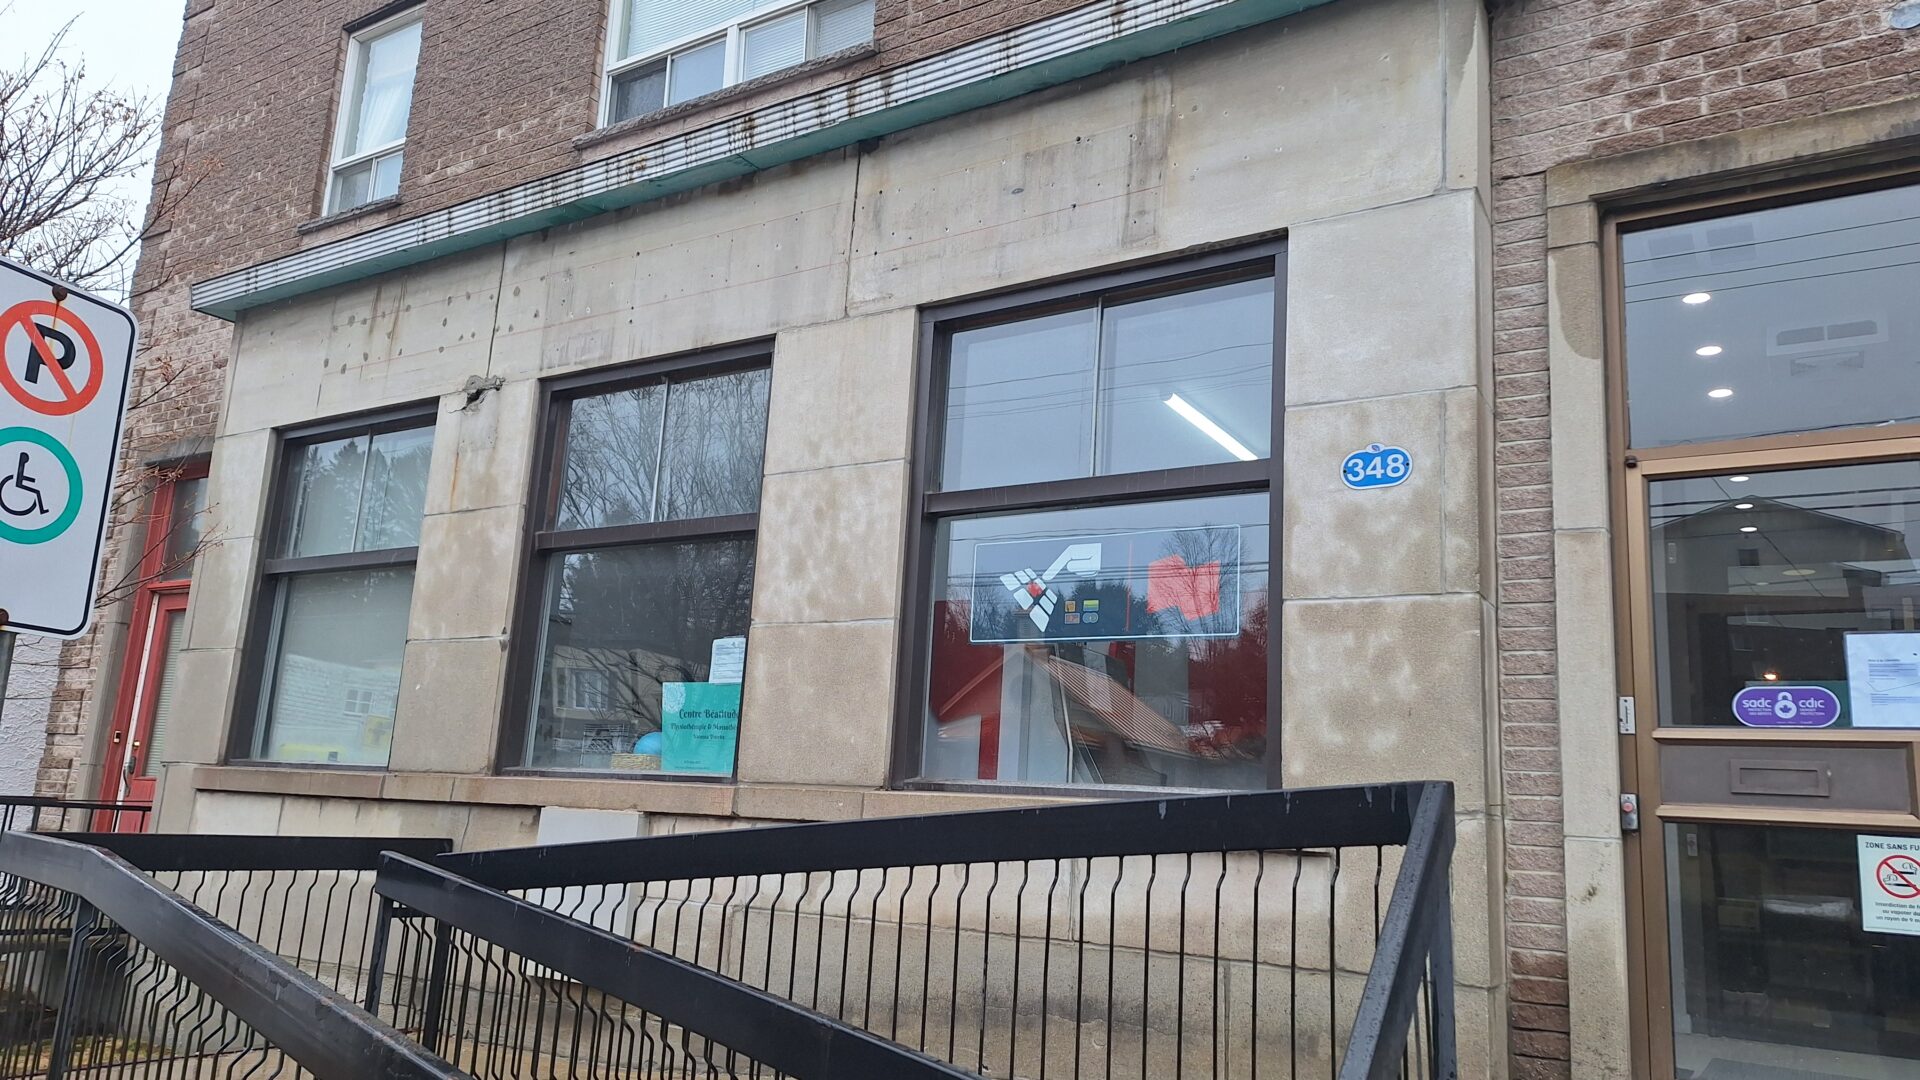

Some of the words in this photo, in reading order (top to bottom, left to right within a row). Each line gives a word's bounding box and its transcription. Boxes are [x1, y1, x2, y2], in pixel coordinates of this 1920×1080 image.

[1347, 454, 1405, 482] 348
[1742, 698, 1772, 708] sadc
[1799, 698, 1825, 708] cdic
[679, 708, 702, 719] Centre
[1865, 841, 1884, 849] ZONE
[1887, 843, 1908, 851] SANS
